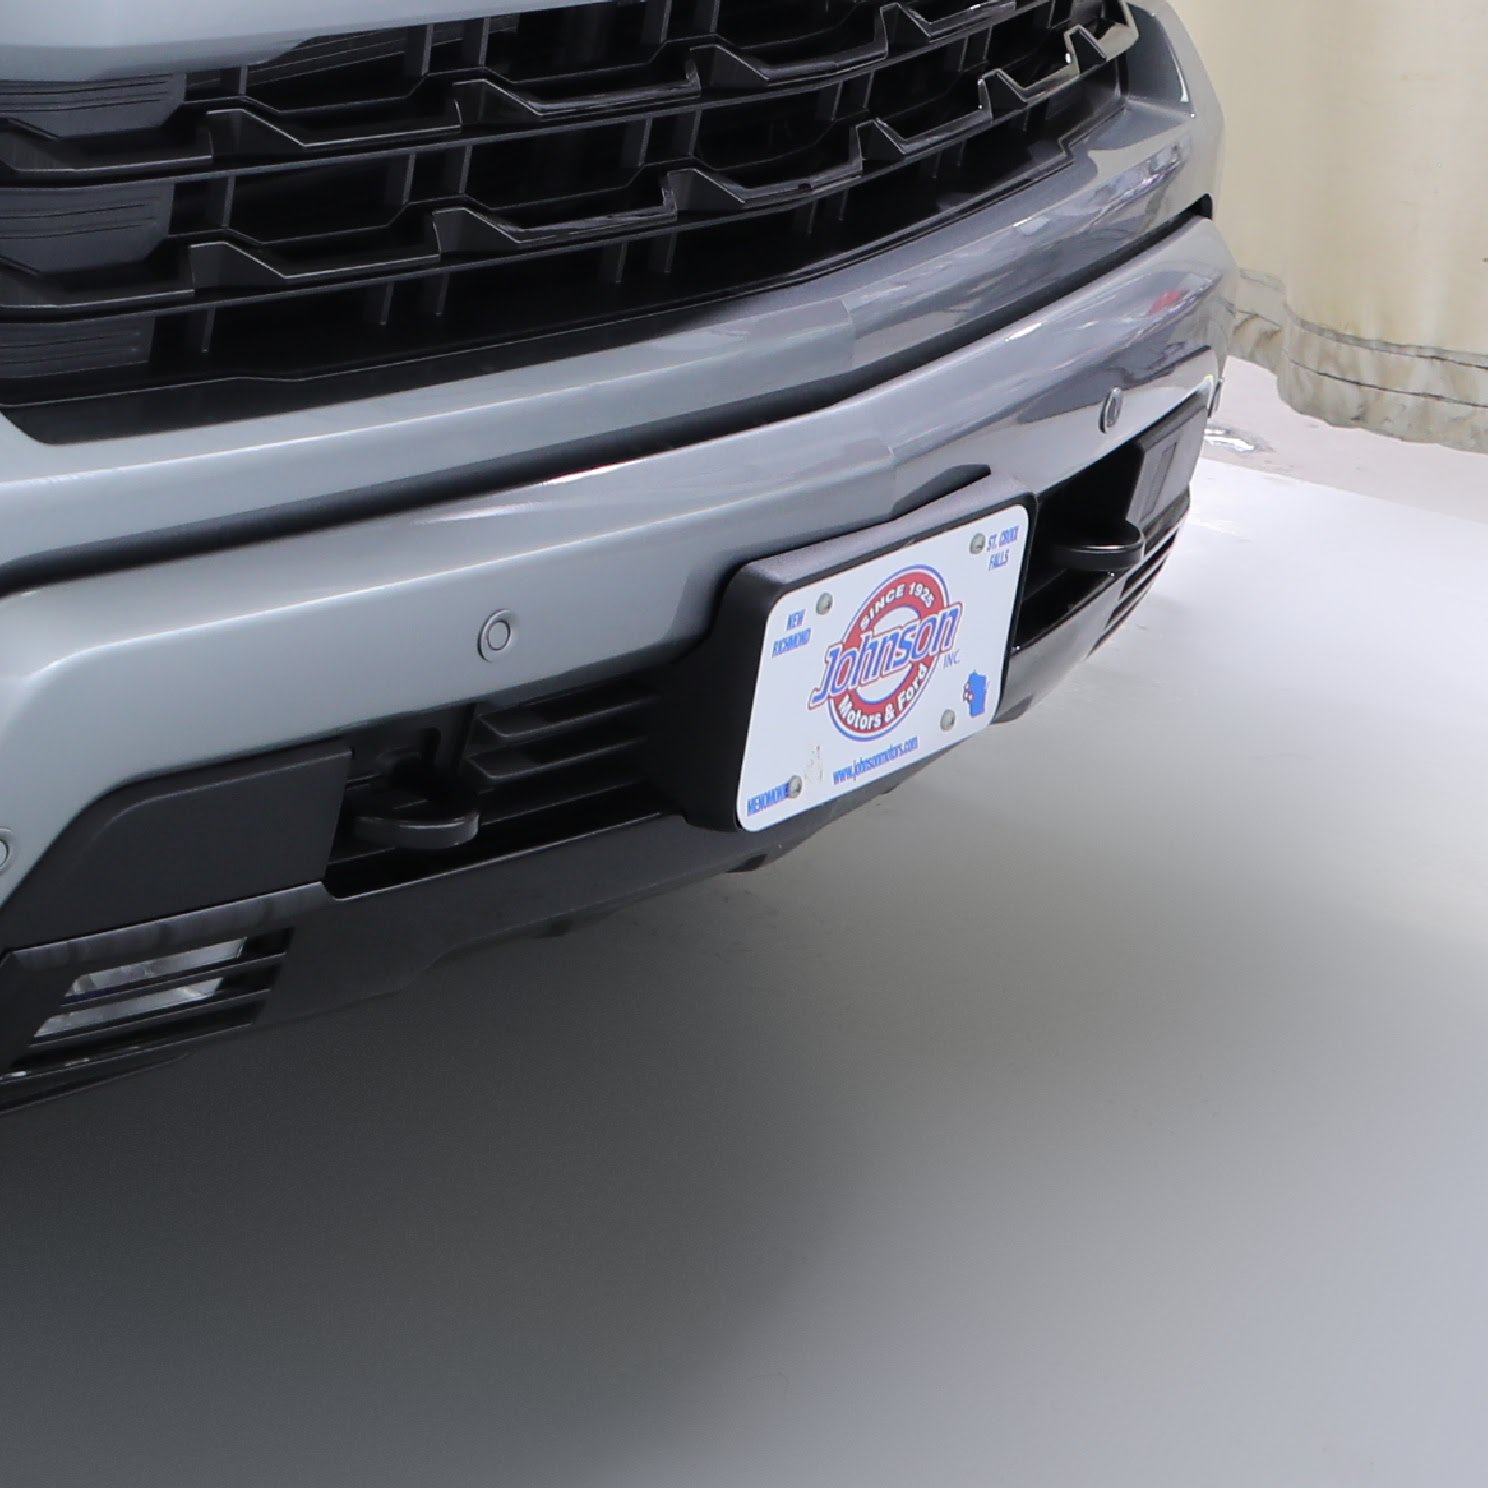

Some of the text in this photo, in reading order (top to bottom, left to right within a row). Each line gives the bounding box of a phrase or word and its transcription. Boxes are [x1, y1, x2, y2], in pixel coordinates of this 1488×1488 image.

[860, 581, 935, 631] SINCE 1925
[809, 602, 962, 710] Johnson
[838, 662, 928, 730] Motors & Ford
[833, 736, 918, 785] www.johnsonmotors.com
